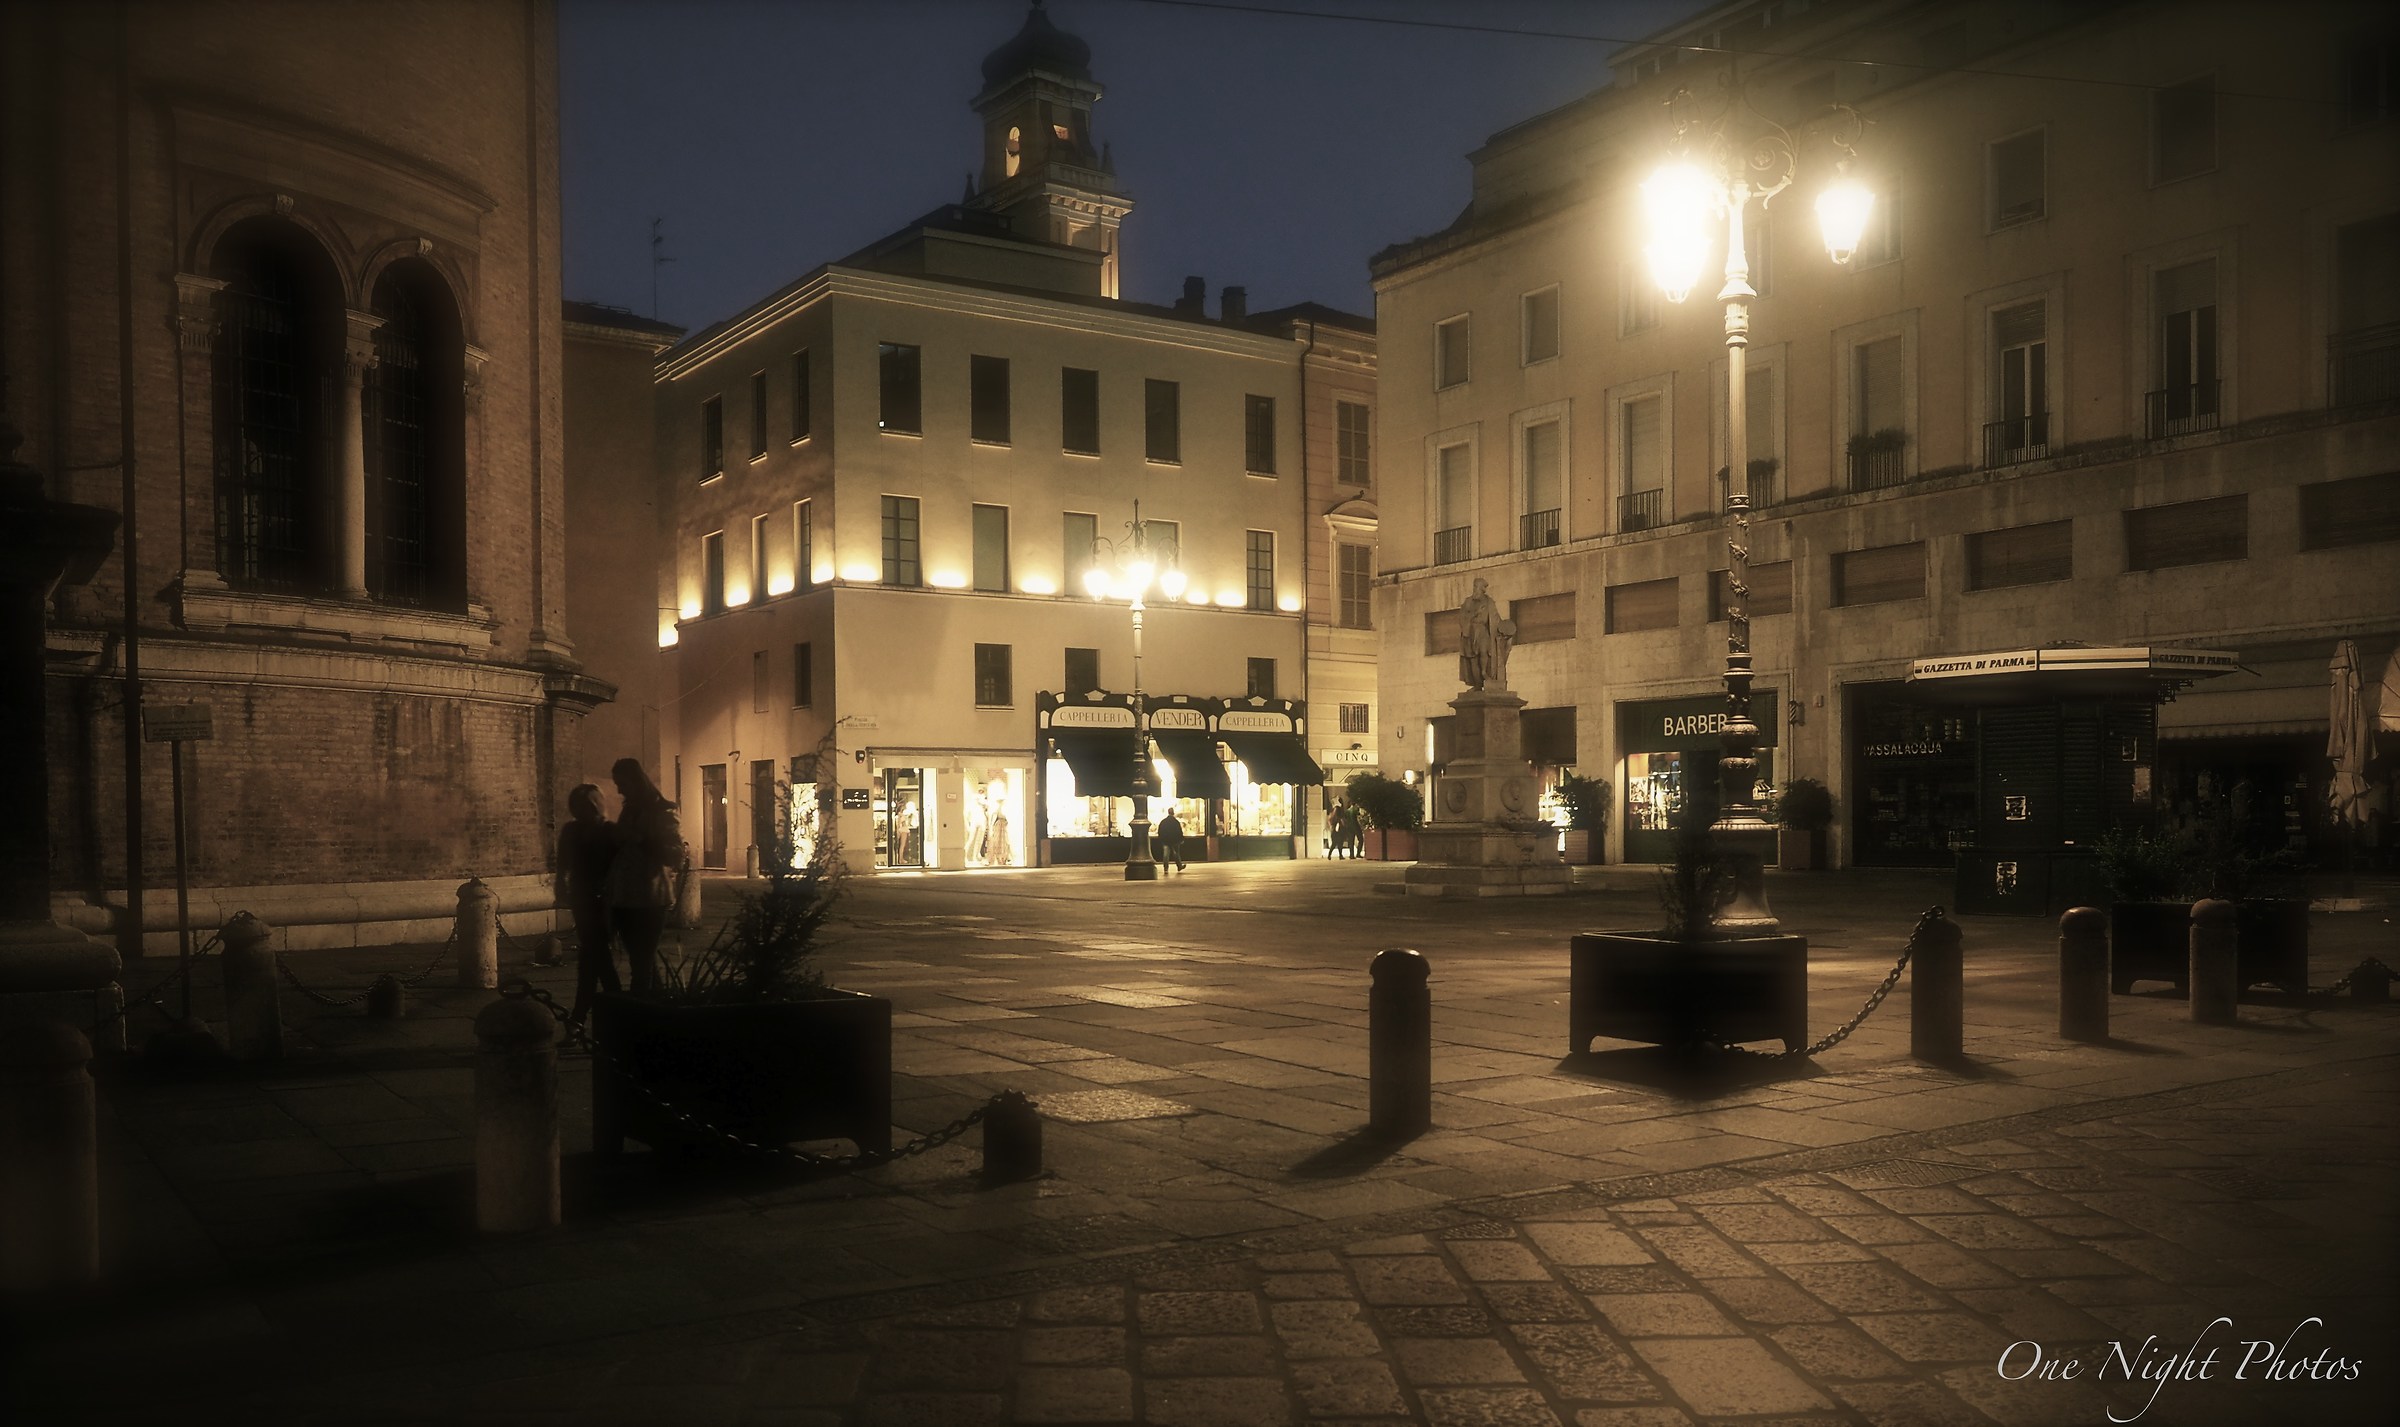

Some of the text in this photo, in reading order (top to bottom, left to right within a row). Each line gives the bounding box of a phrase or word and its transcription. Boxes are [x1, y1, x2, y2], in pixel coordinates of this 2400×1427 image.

[1923, 657, 2024, 673] GAZZETTA DI PARMA
[2159, 655, 2195, 664] GAZZETTA
[1059, 711, 1128, 723] CAPPELLERIA
[1156, 712, 1202, 726] VENDER
[1225, 716, 1285, 728] CAPPELLERIA
[1664, 713, 1728, 736] BARBER
[1336, 752, 1369, 762] CINQ
